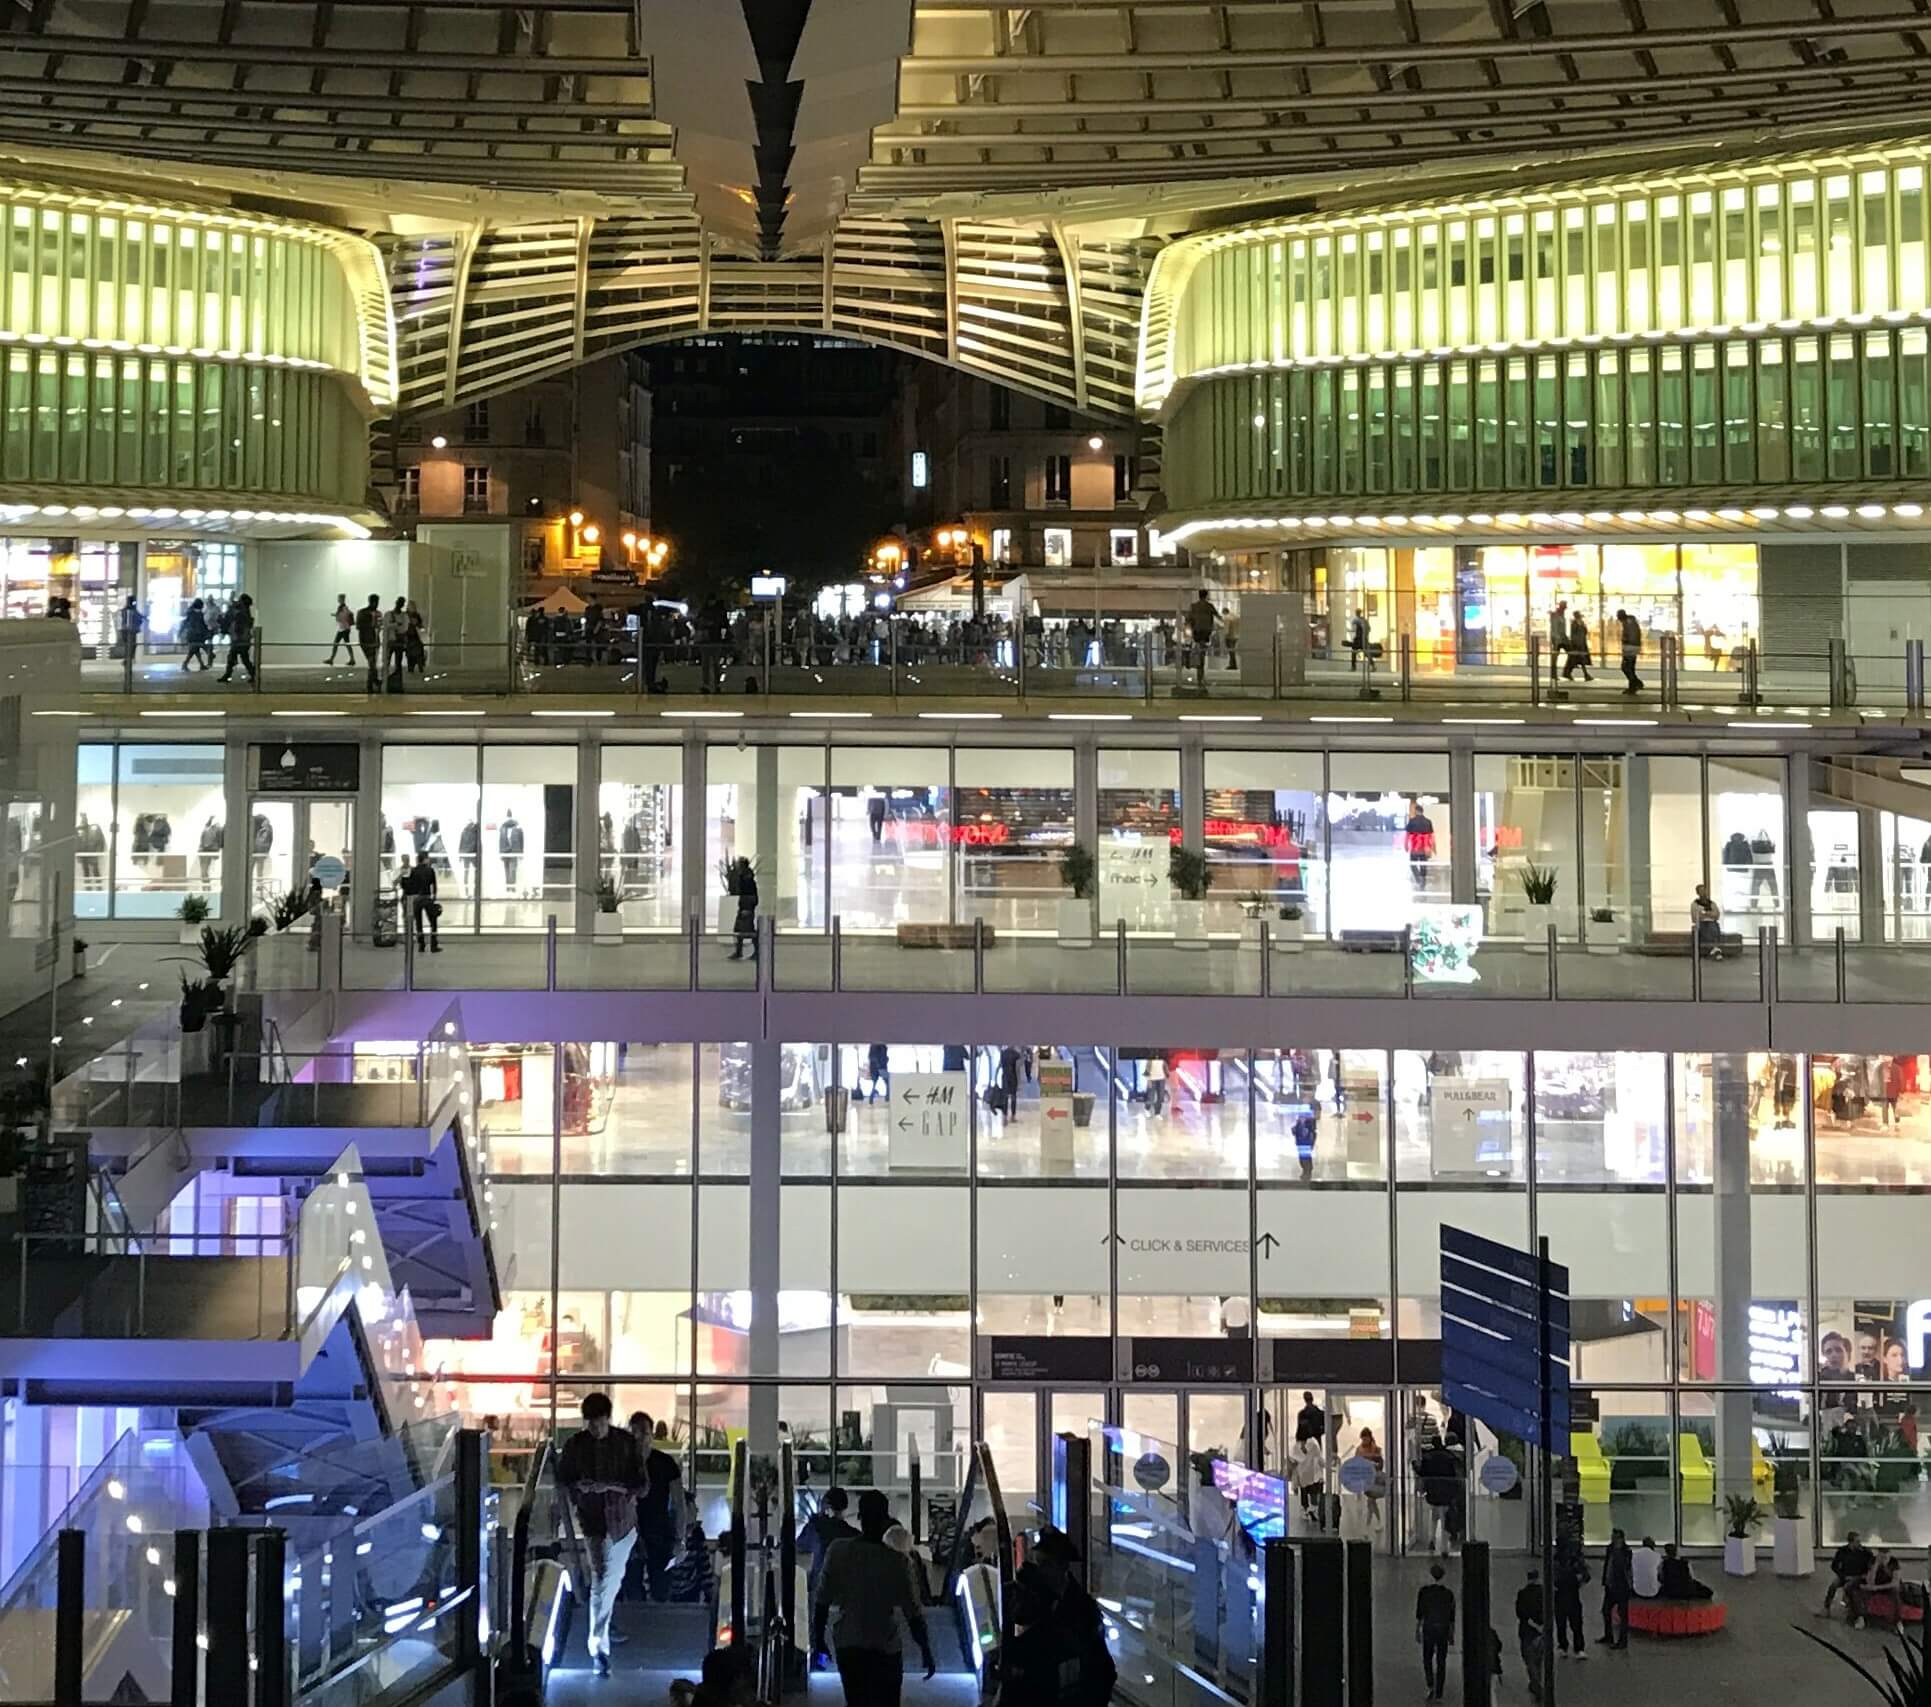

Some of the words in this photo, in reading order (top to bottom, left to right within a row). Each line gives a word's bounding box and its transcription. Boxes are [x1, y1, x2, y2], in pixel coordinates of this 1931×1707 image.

[921, 1110, 957, 1136] GAP
[1130, 1239, 1171, 1252] CLICK
[1173, 1240, 1182, 1251] &
[1186, 1239, 1249, 1253] SERVICES
